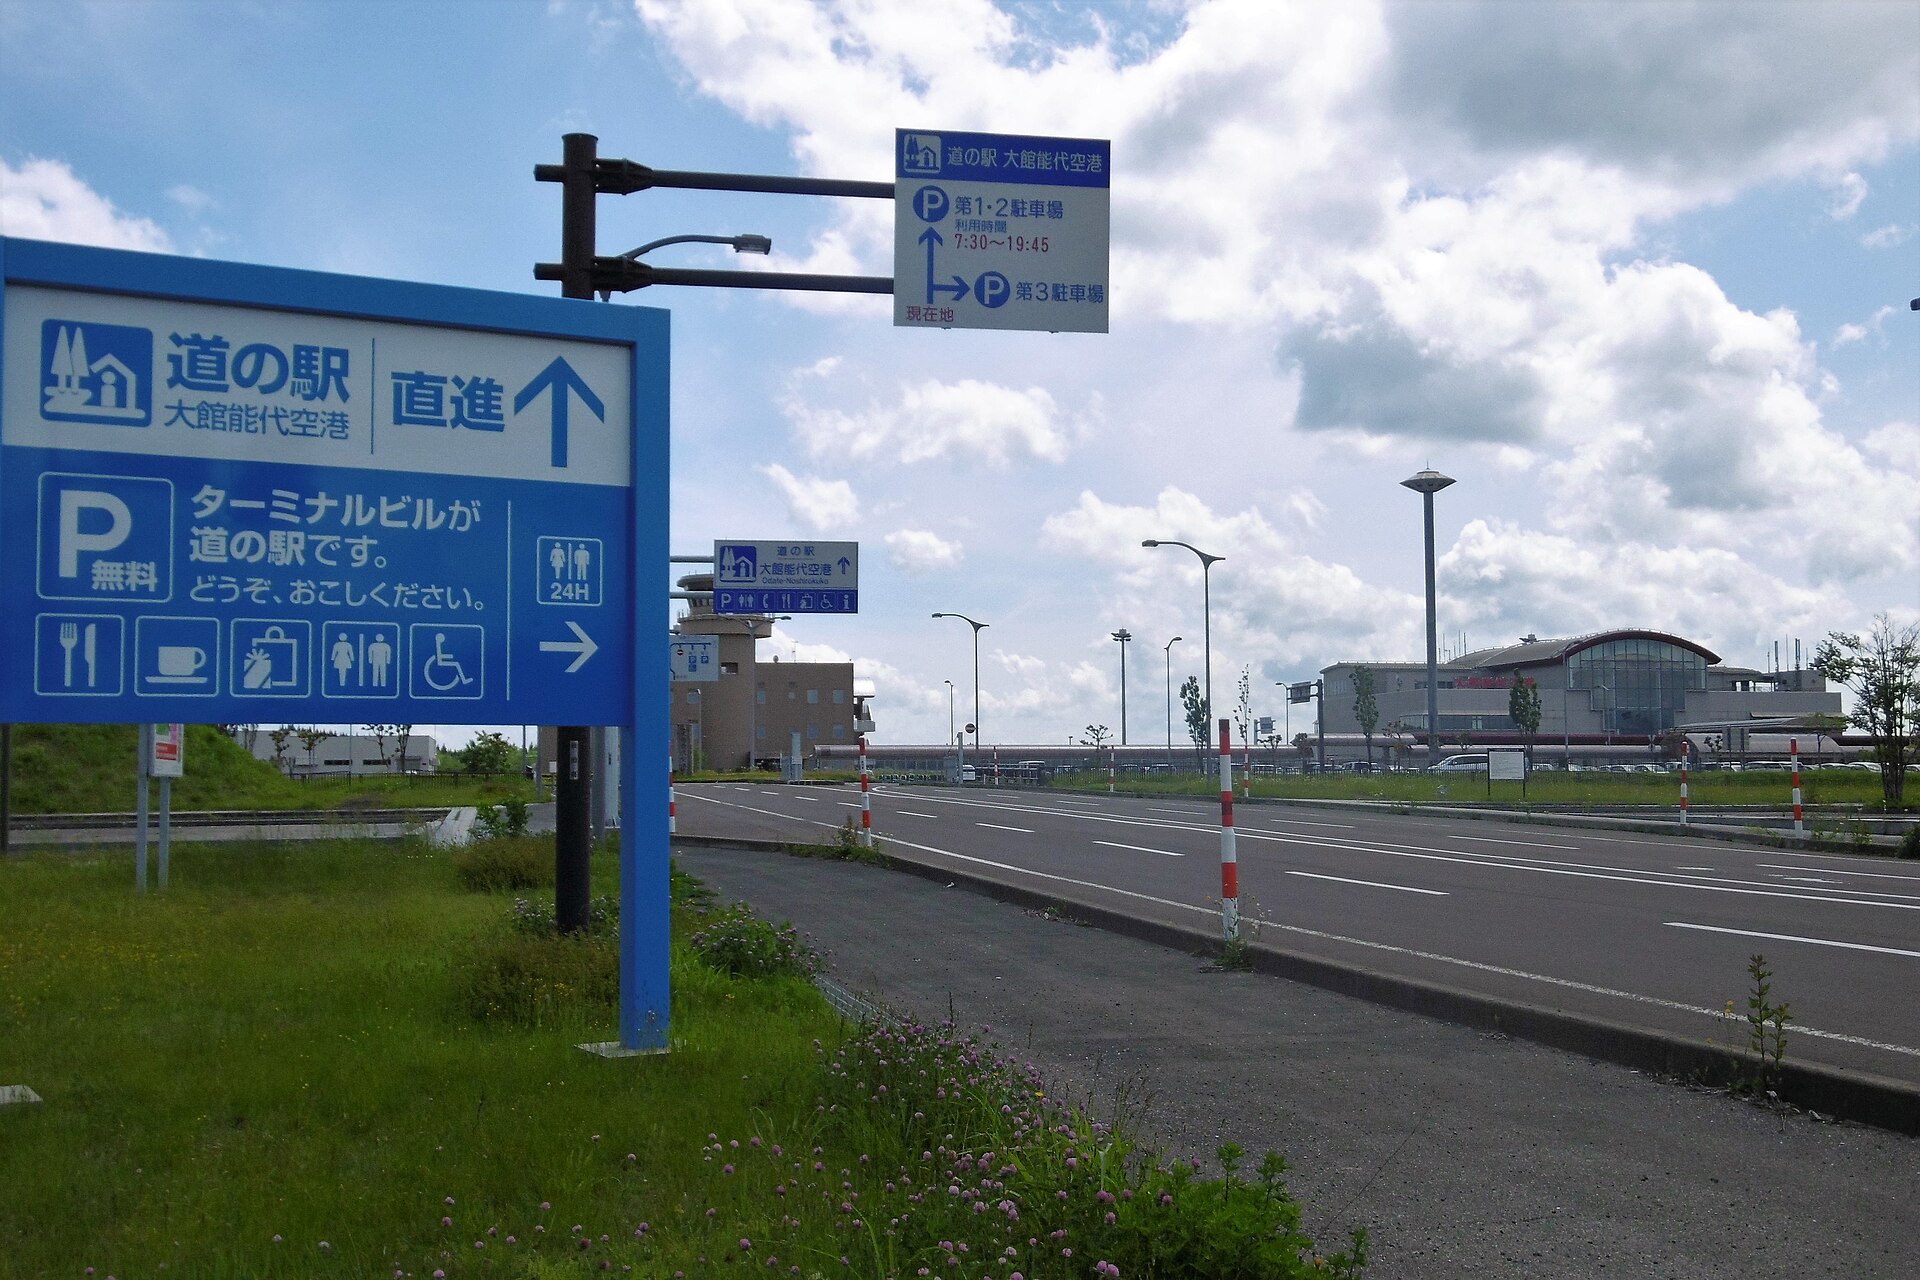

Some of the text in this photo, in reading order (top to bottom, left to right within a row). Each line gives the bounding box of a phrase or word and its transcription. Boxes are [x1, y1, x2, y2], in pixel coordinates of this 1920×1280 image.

[947, 147, 1103, 173] 道の駅 大館能代空港
[923, 189, 943, 219] P
[954, 220, 1007, 233] 利用時間
[984, 276, 1004, 305] P
[1016, 282, 1104, 304] 第3駐車場
[906, 305, 954, 322] 現在地
[166, 332, 350, 405] 道の駅
[391, 368, 505, 433] 直進
[164, 401, 349, 440] 大館能代空港
[191, 485, 481, 532] ターミナルビルが
[58, 489, 132, 578] P
[190, 527, 387, 568] 道の駅です。
[777, 545, 815, 557] 道の駅
[92, 559, 158, 593] 無料
[760, 562, 832, 576] 大館能代空港
[190, 576, 484, 611] どうぞ、おこしください。
[550, 583, 590, 602] 24H
[721, 593, 731, 609] P
